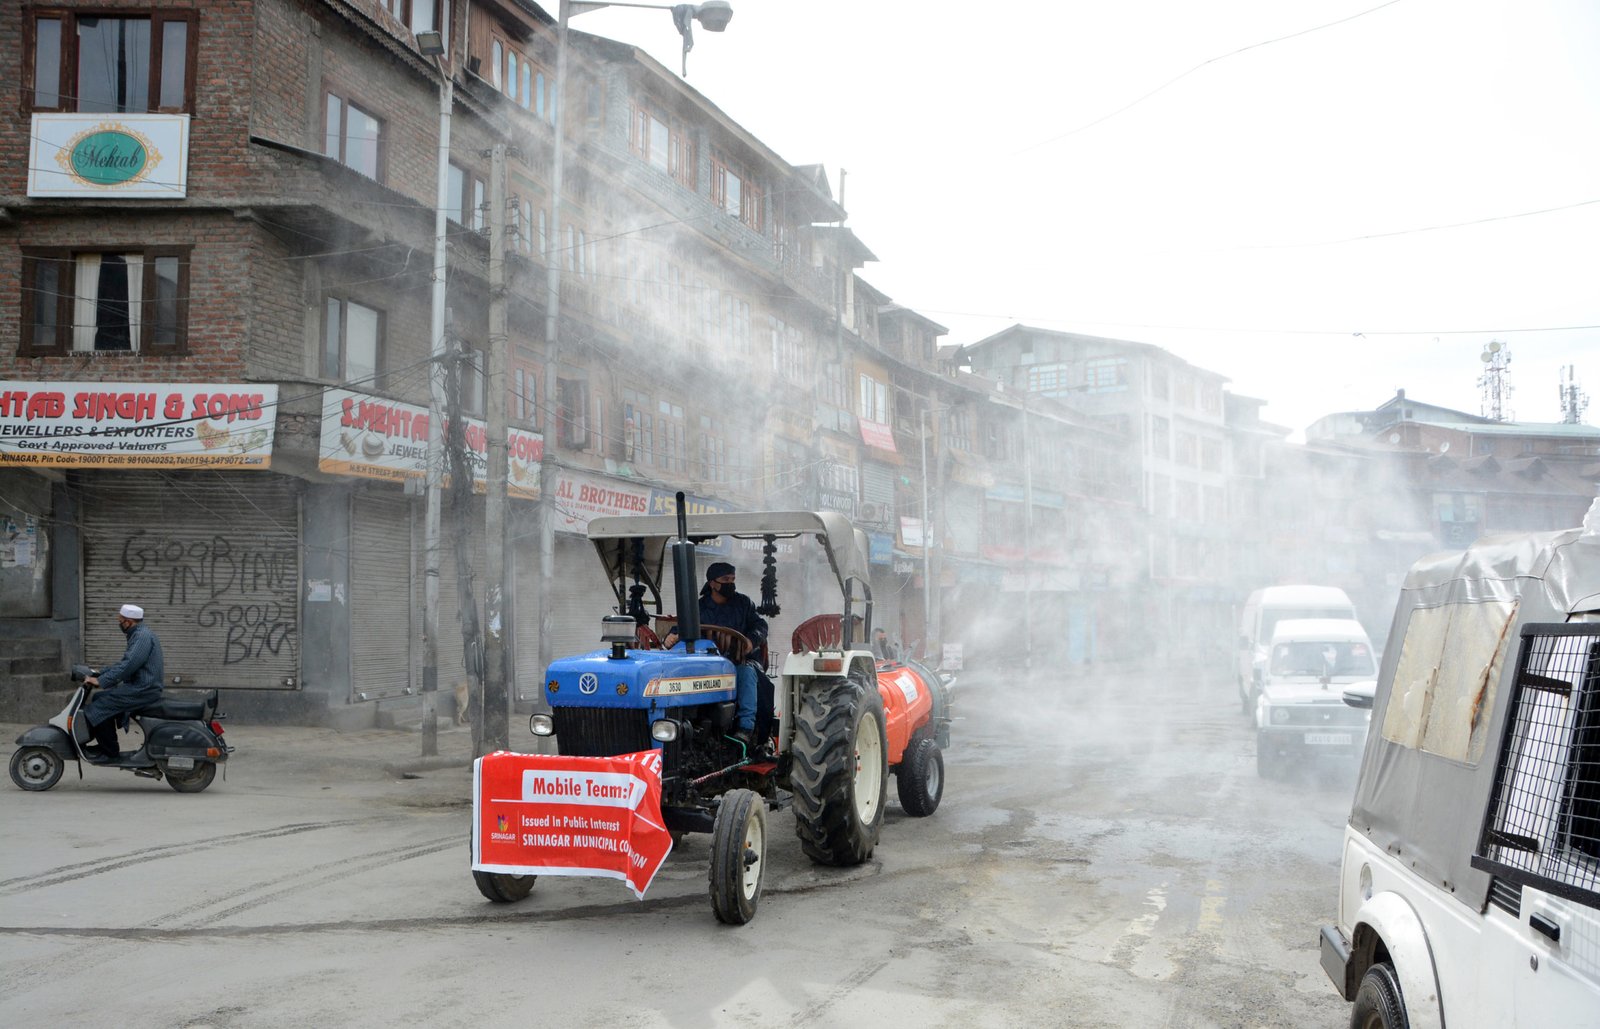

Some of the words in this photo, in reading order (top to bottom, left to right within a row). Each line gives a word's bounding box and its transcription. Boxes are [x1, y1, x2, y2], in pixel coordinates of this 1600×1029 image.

[76, 144, 143, 169] Mehtab
[72, 392, 157, 423] SINGH
[163, 393, 184, 420] &
[191, 393, 264, 424] SONS
[0, 425, 84, 438] EWELLERS
[88, 426, 98, 437] &
[104, 426, 195, 438] EXPORTERS
[17, 440, 48, 450] Govt
[52, 441, 114, 452] Approved
[118, 441, 168, 451] Valuers
[41, 455, 54, 463] Pin
[108, 456, 125, 464] Cell:
[579, 483, 647, 513] BROTHERS
[197, 601, 282, 627] GOOD
[224, 623, 296, 665] BACK
[669, 682, 682, 692] 3630
[692, 681, 703, 690] NEW
[703, 678, 721, 689] HOLLAND
[533, 777, 581, 796] Mobile
[521, 815, 550, 827] Issued
[552, 816, 561, 827] In
[563, 816, 589, 829] Public
[590, 818, 620, 831] Interest
[491, 833, 516, 841] SRINAGAR
[522, 834, 570, 848] SRINAGAR
[573, 835, 617, 852] MUNICIPAL
